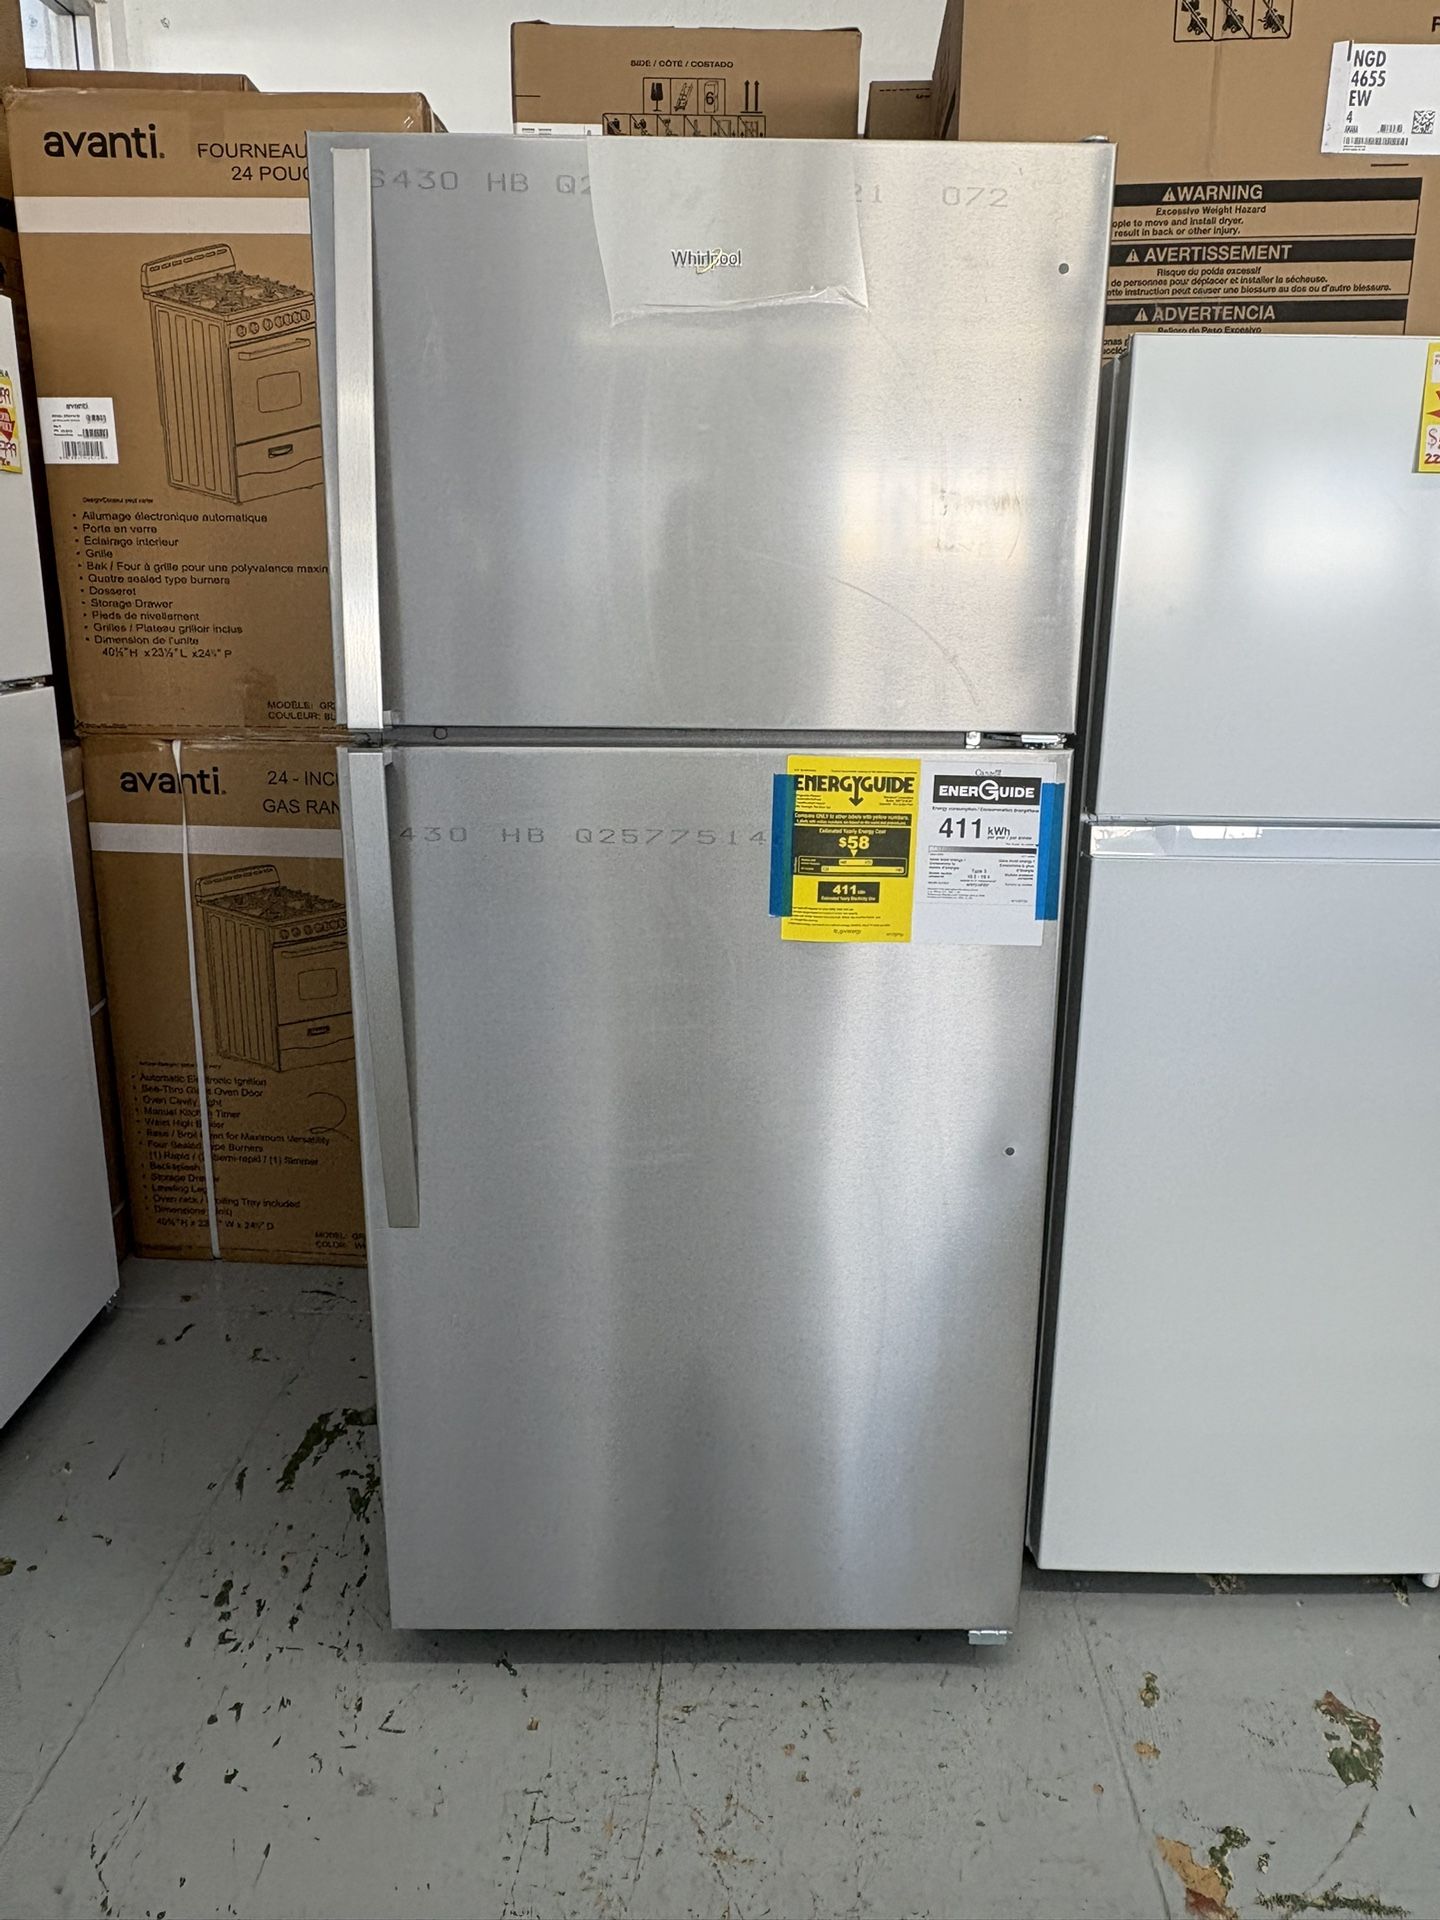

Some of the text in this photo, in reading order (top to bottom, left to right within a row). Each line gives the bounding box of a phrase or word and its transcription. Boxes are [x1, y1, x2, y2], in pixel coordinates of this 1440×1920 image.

[630, 59, 652, 68] SIDE
[690, 60, 734, 69] COSTADO
[1353, 50, 1387, 67] NGD
[1351, 70, 1386, 87] 4655
[705, 91, 715, 105] 6
[1349, 90, 1372, 107] EW
[1346, 111, 1353, 123] 4
[197, 143, 307, 159] FOURNEAU
[232, 166, 253, 181] 24
[487, 172, 529, 193] HB
[942, 185, 1009, 208] 072
[1177, 184, 1263, 201] WARNING
[1202, 206, 1232, 216] Weight
[1235, 205, 1266, 215] Hazard
[1134, 216, 1244, 228] to move and install dryer.
[1114, 226, 1241, 238] result in back or other injury.
[671, 248, 742, 272] Whirlpool
[1144, 245, 1292, 263] AVERTISSEMENT
[1157, 268, 1186, 278] Risque
[1123, 279, 1168, 289] personnes
[1230, 276, 1238, 284] et
[1240, 275, 1274, 285] installer
[1125, 287, 1170, 296] instruction
[1151, 305, 1276, 322] ADVERTENCIA
[82, 510, 267, 524] Allumage électronique automatique
[82, 523, 110, 533] Porte
[86, 549, 113, 558] Grille
[117, 562, 141, 570] Four
[154, 562, 178, 574] grille
[182, 565, 204, 574] pour
[209, 564, 227, 572] une
[231, 563, 293, 575] polyvalence
[88, 573, 124, 583] Quatre
[165, 575, 187, 586] type
[190, 575, 231, 584] burners
[91, 598, 173, 609] Storage Drawer
[92, 611, 200, 621] Pieds de nivellement
[93, 622, 127, 632] Grilles
[136, 623, 175, 632] Plateau
[213, 624, 243, 634] inclus
[94, 634, 150, 644] Dimension
[153, 635, 165, 644] de
[267, 770, 288, 785] 24
[794, 775, 915, 794] ENERGYGUIDE
[939, 780, 1035, 801] ENERGUIDE
[263, 798, 300, 814] GAS
[939, 817, 1011, 839] 411 kWh
[502, 827, 544, 844] HB
[575, 828, 766, 845] Q2577514
[838, 836, 870, 849] $58
[832, 884, 858, 895] 411
